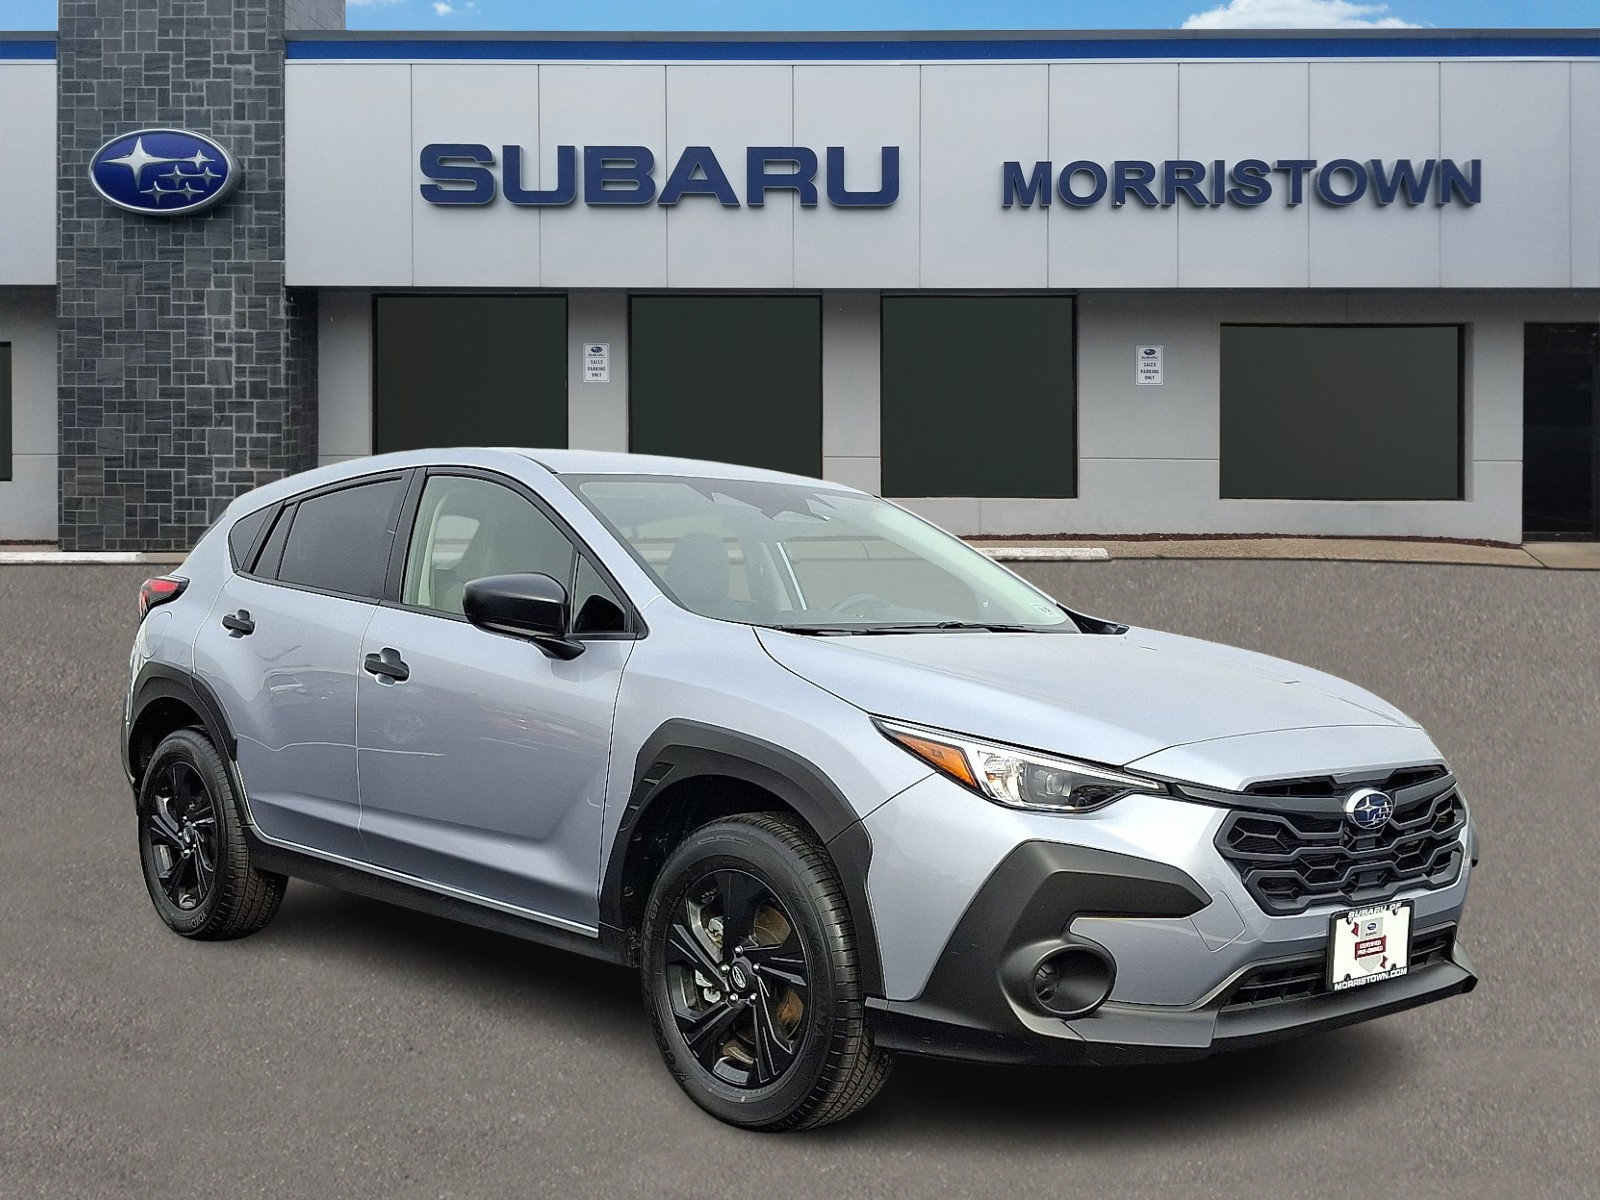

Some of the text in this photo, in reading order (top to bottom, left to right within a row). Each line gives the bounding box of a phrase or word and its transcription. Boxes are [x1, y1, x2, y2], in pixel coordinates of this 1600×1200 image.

[420, 143, 900, 207] SUBARU
[1001, 159, 1482, 208] MORRISTOWN
[1348, 905, 1387, 917] SUBARU
[1334, 967, 1407, 990] MORRISTOWN.COM
